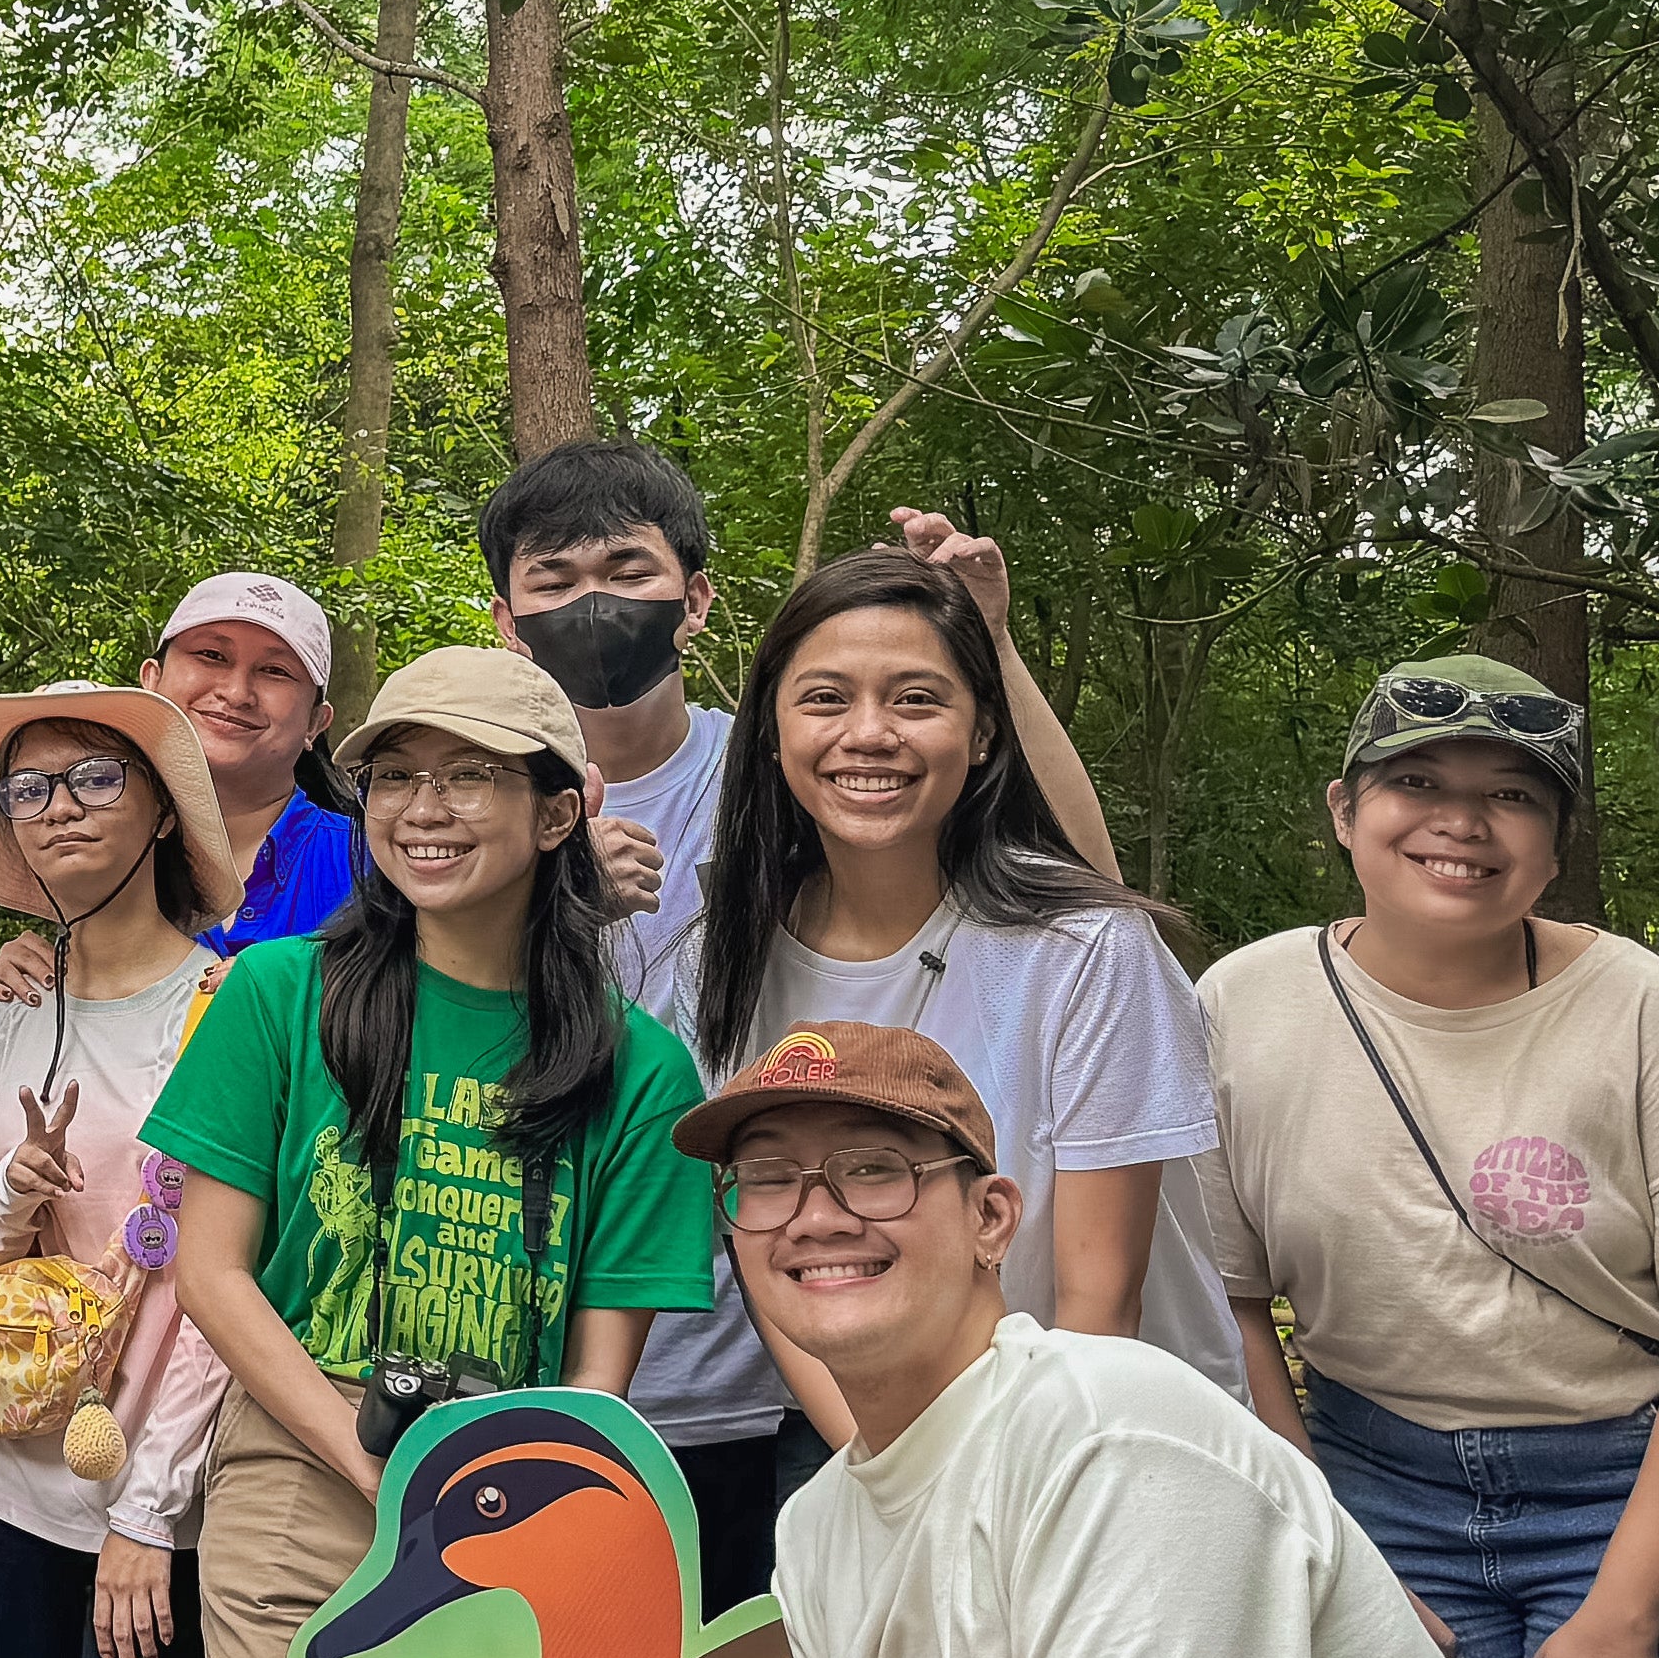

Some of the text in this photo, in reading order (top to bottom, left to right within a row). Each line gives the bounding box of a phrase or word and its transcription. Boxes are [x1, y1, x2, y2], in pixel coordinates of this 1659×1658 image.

[1473, 1136, 1588, 1181] CITIZEN
[1469, 1172, 1591, 1205] OF THE
[1473, 1194, 1585, 1236] SEA
[437, 1222, 497, 1255] and
